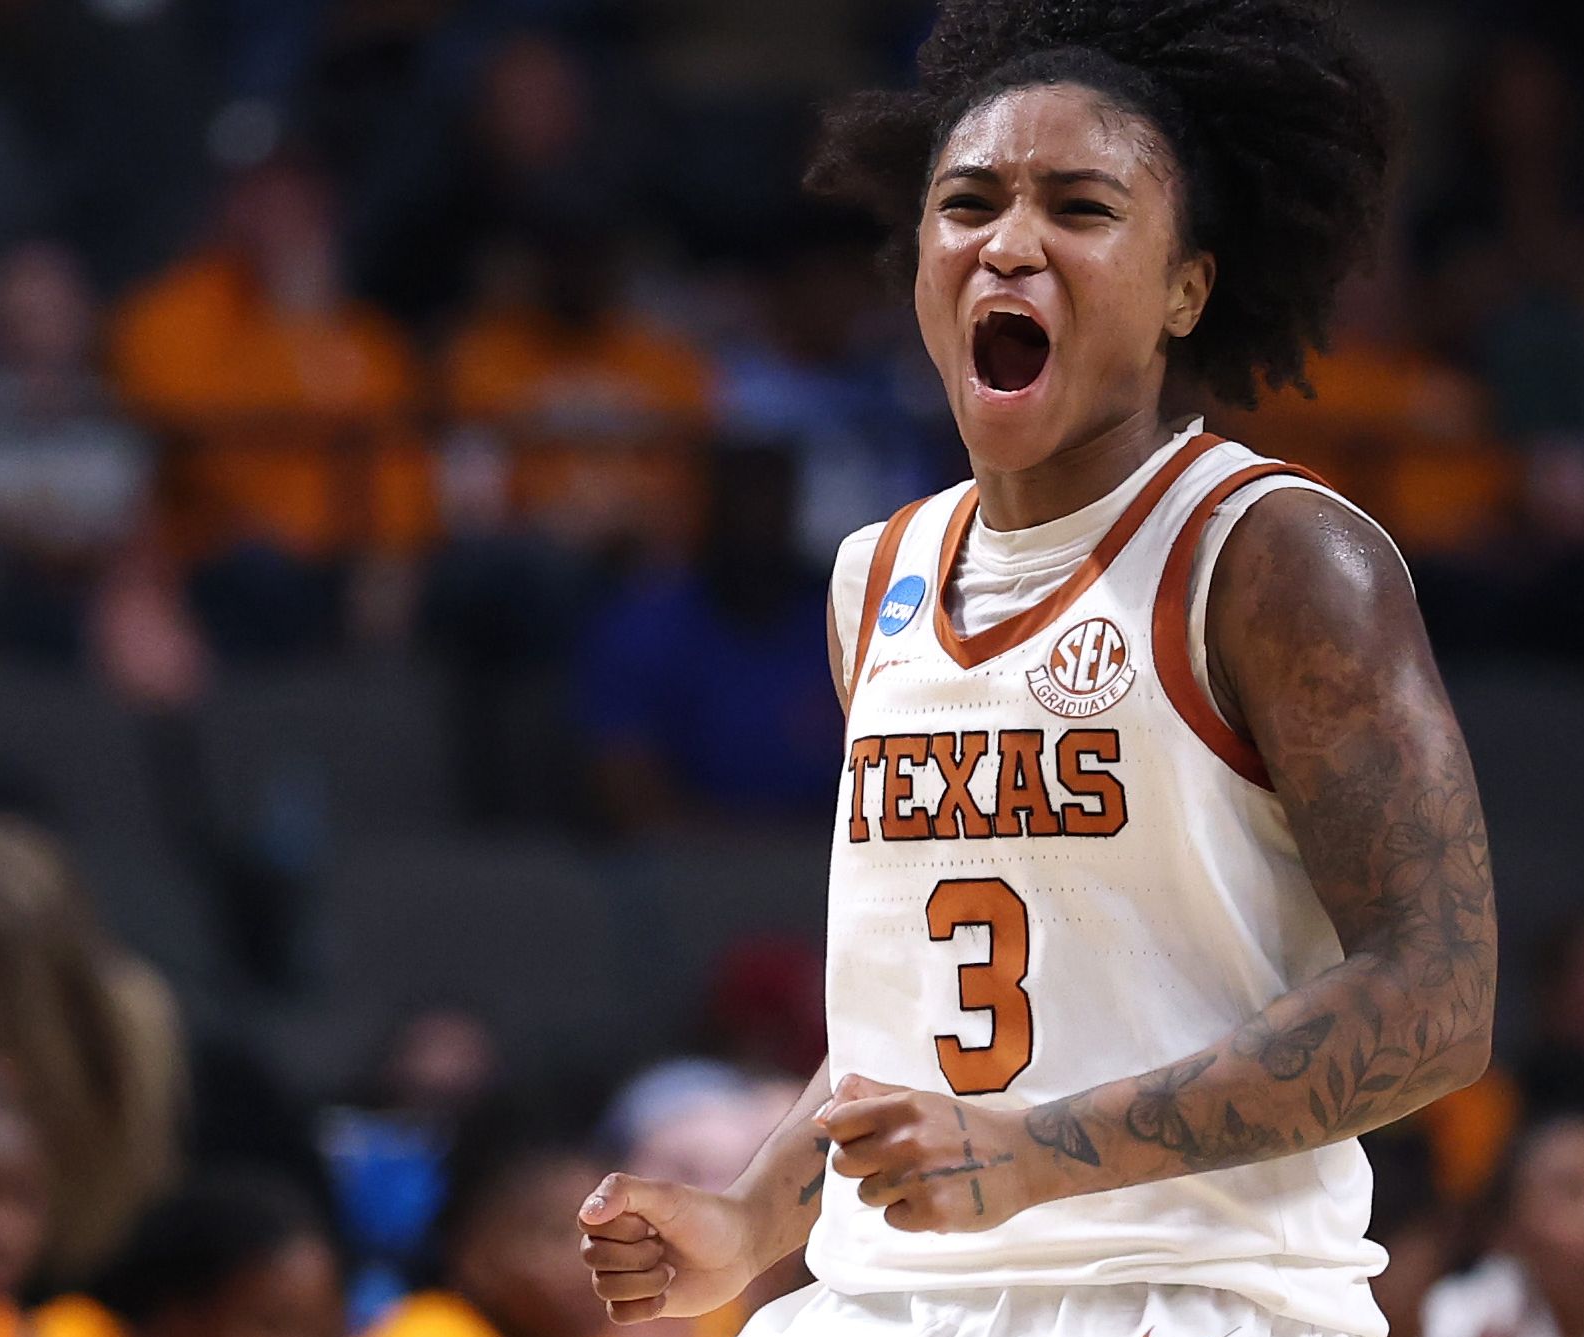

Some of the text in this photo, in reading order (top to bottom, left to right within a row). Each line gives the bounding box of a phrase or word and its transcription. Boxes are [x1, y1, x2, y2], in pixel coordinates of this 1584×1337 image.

[1036, 685, 1119, 715] GRADUATE
[1054, 620, 1122, 691] SEC
[849, 729, 1128, 843] TEXAS
[926, 877, 1033, 1096] 3
